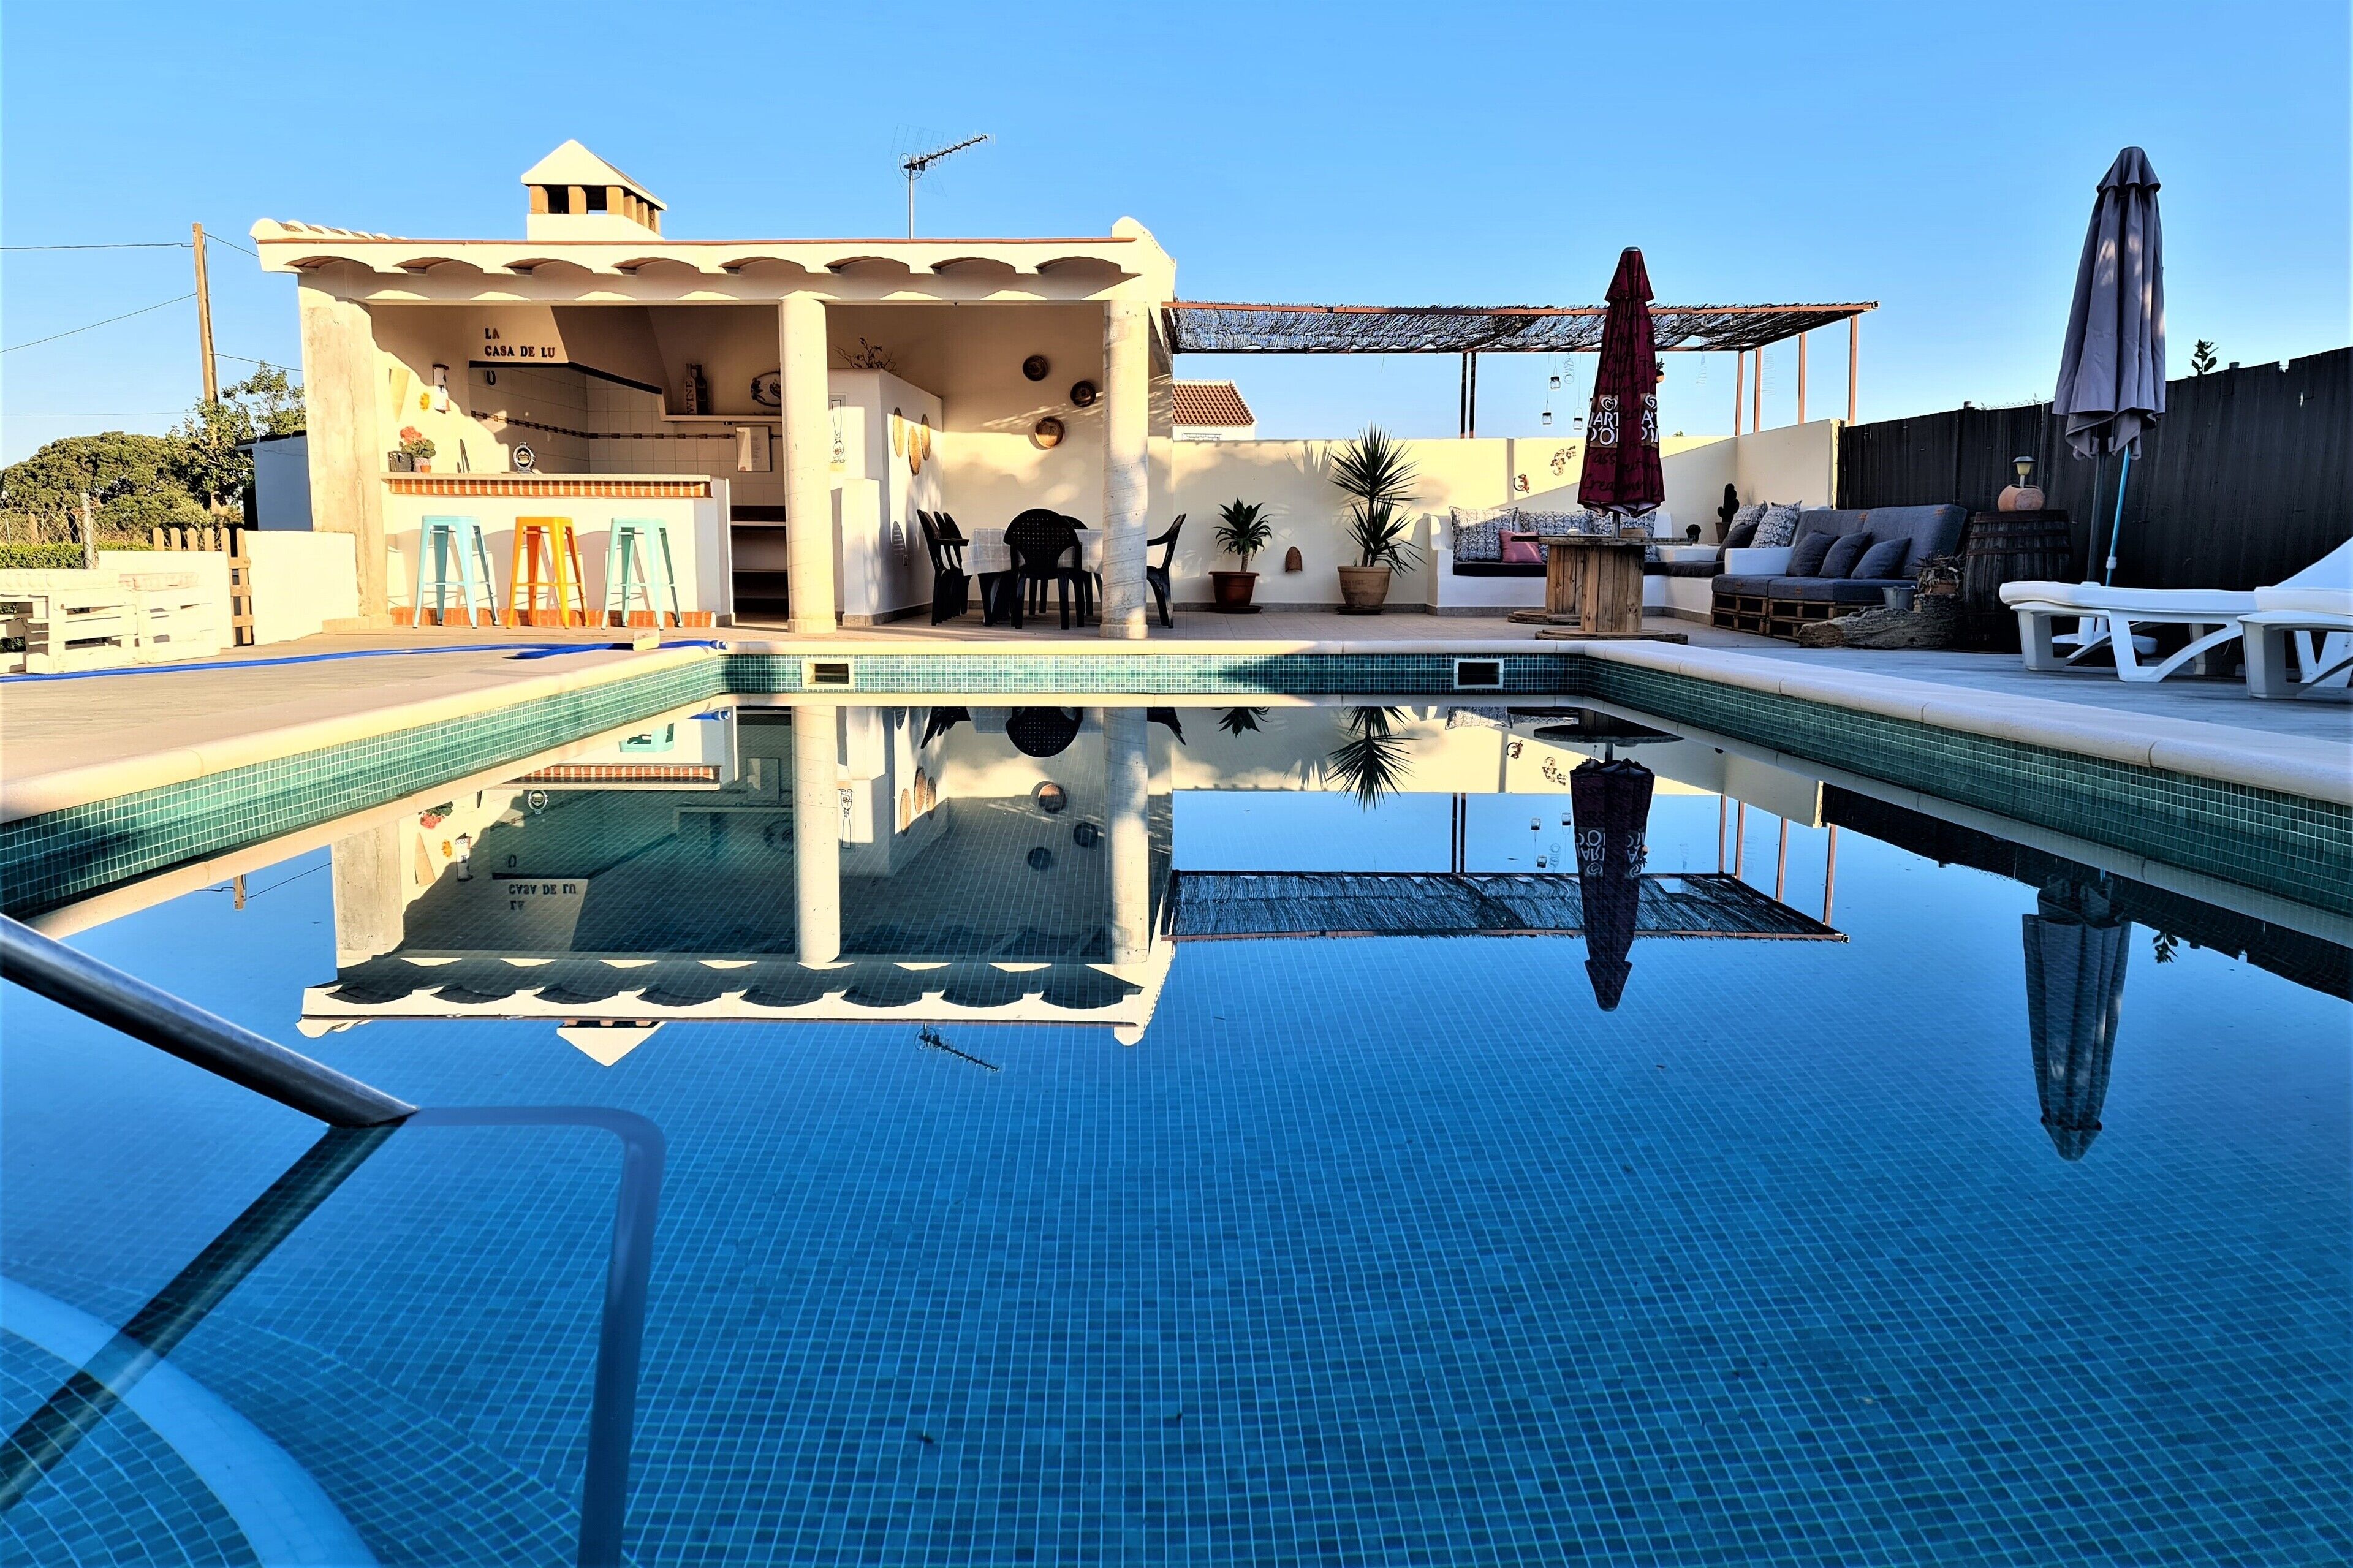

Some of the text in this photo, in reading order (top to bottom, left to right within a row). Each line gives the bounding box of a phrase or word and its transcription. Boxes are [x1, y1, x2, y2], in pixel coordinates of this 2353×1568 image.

[485, 328, 500, 339] LA
[484, 345, 555, 358] CASA DE LU
[686, 380, 694, 413] WINE
